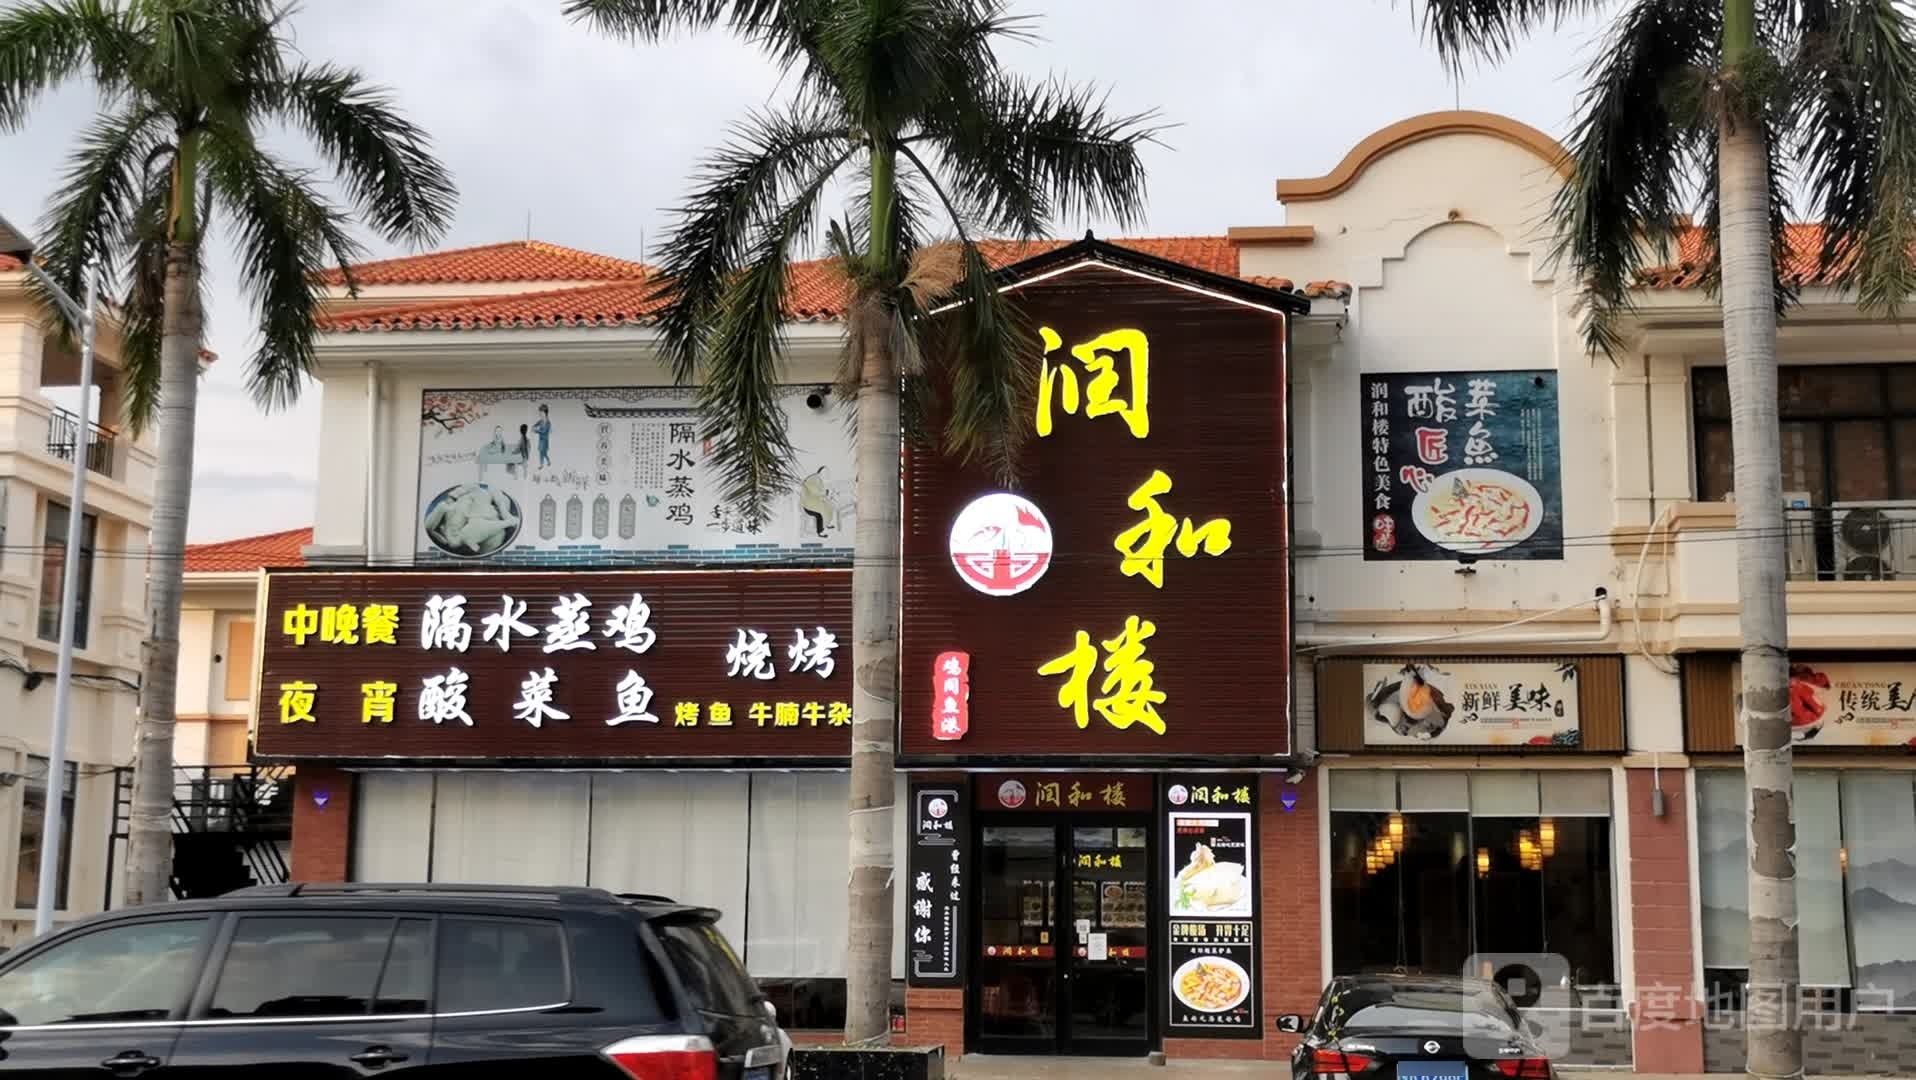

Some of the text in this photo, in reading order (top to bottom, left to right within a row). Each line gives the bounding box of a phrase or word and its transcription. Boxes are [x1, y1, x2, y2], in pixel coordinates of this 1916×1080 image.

[1370, 382, 1392, 510] 润和楼特色美食
[664, 422, 698, 527] 隔水蒸鸡
[1036, 326, 1232, 734] 润和楼
[282, 603, 400, 647] 中晚餐
[420, 594, 657, 654] 隔水蒸鸡
[726, 627, 840, 681] 烧烤
[278, 681, 399, 723] 夜宵
[416, 666, 661, 728] 酸菜鱼
[674, 701, 852, 728] 烤鱼 牛腩牛杂
[1462, 682, 1552, 712] 新鲜美味
[1839, 681, 1916, 712] 传统美
[1035, 781, 1127, 808] 润和楼
[1190, 785, 1251, 805] 润和楼
[912, 871, 934, 945] 感谢你
